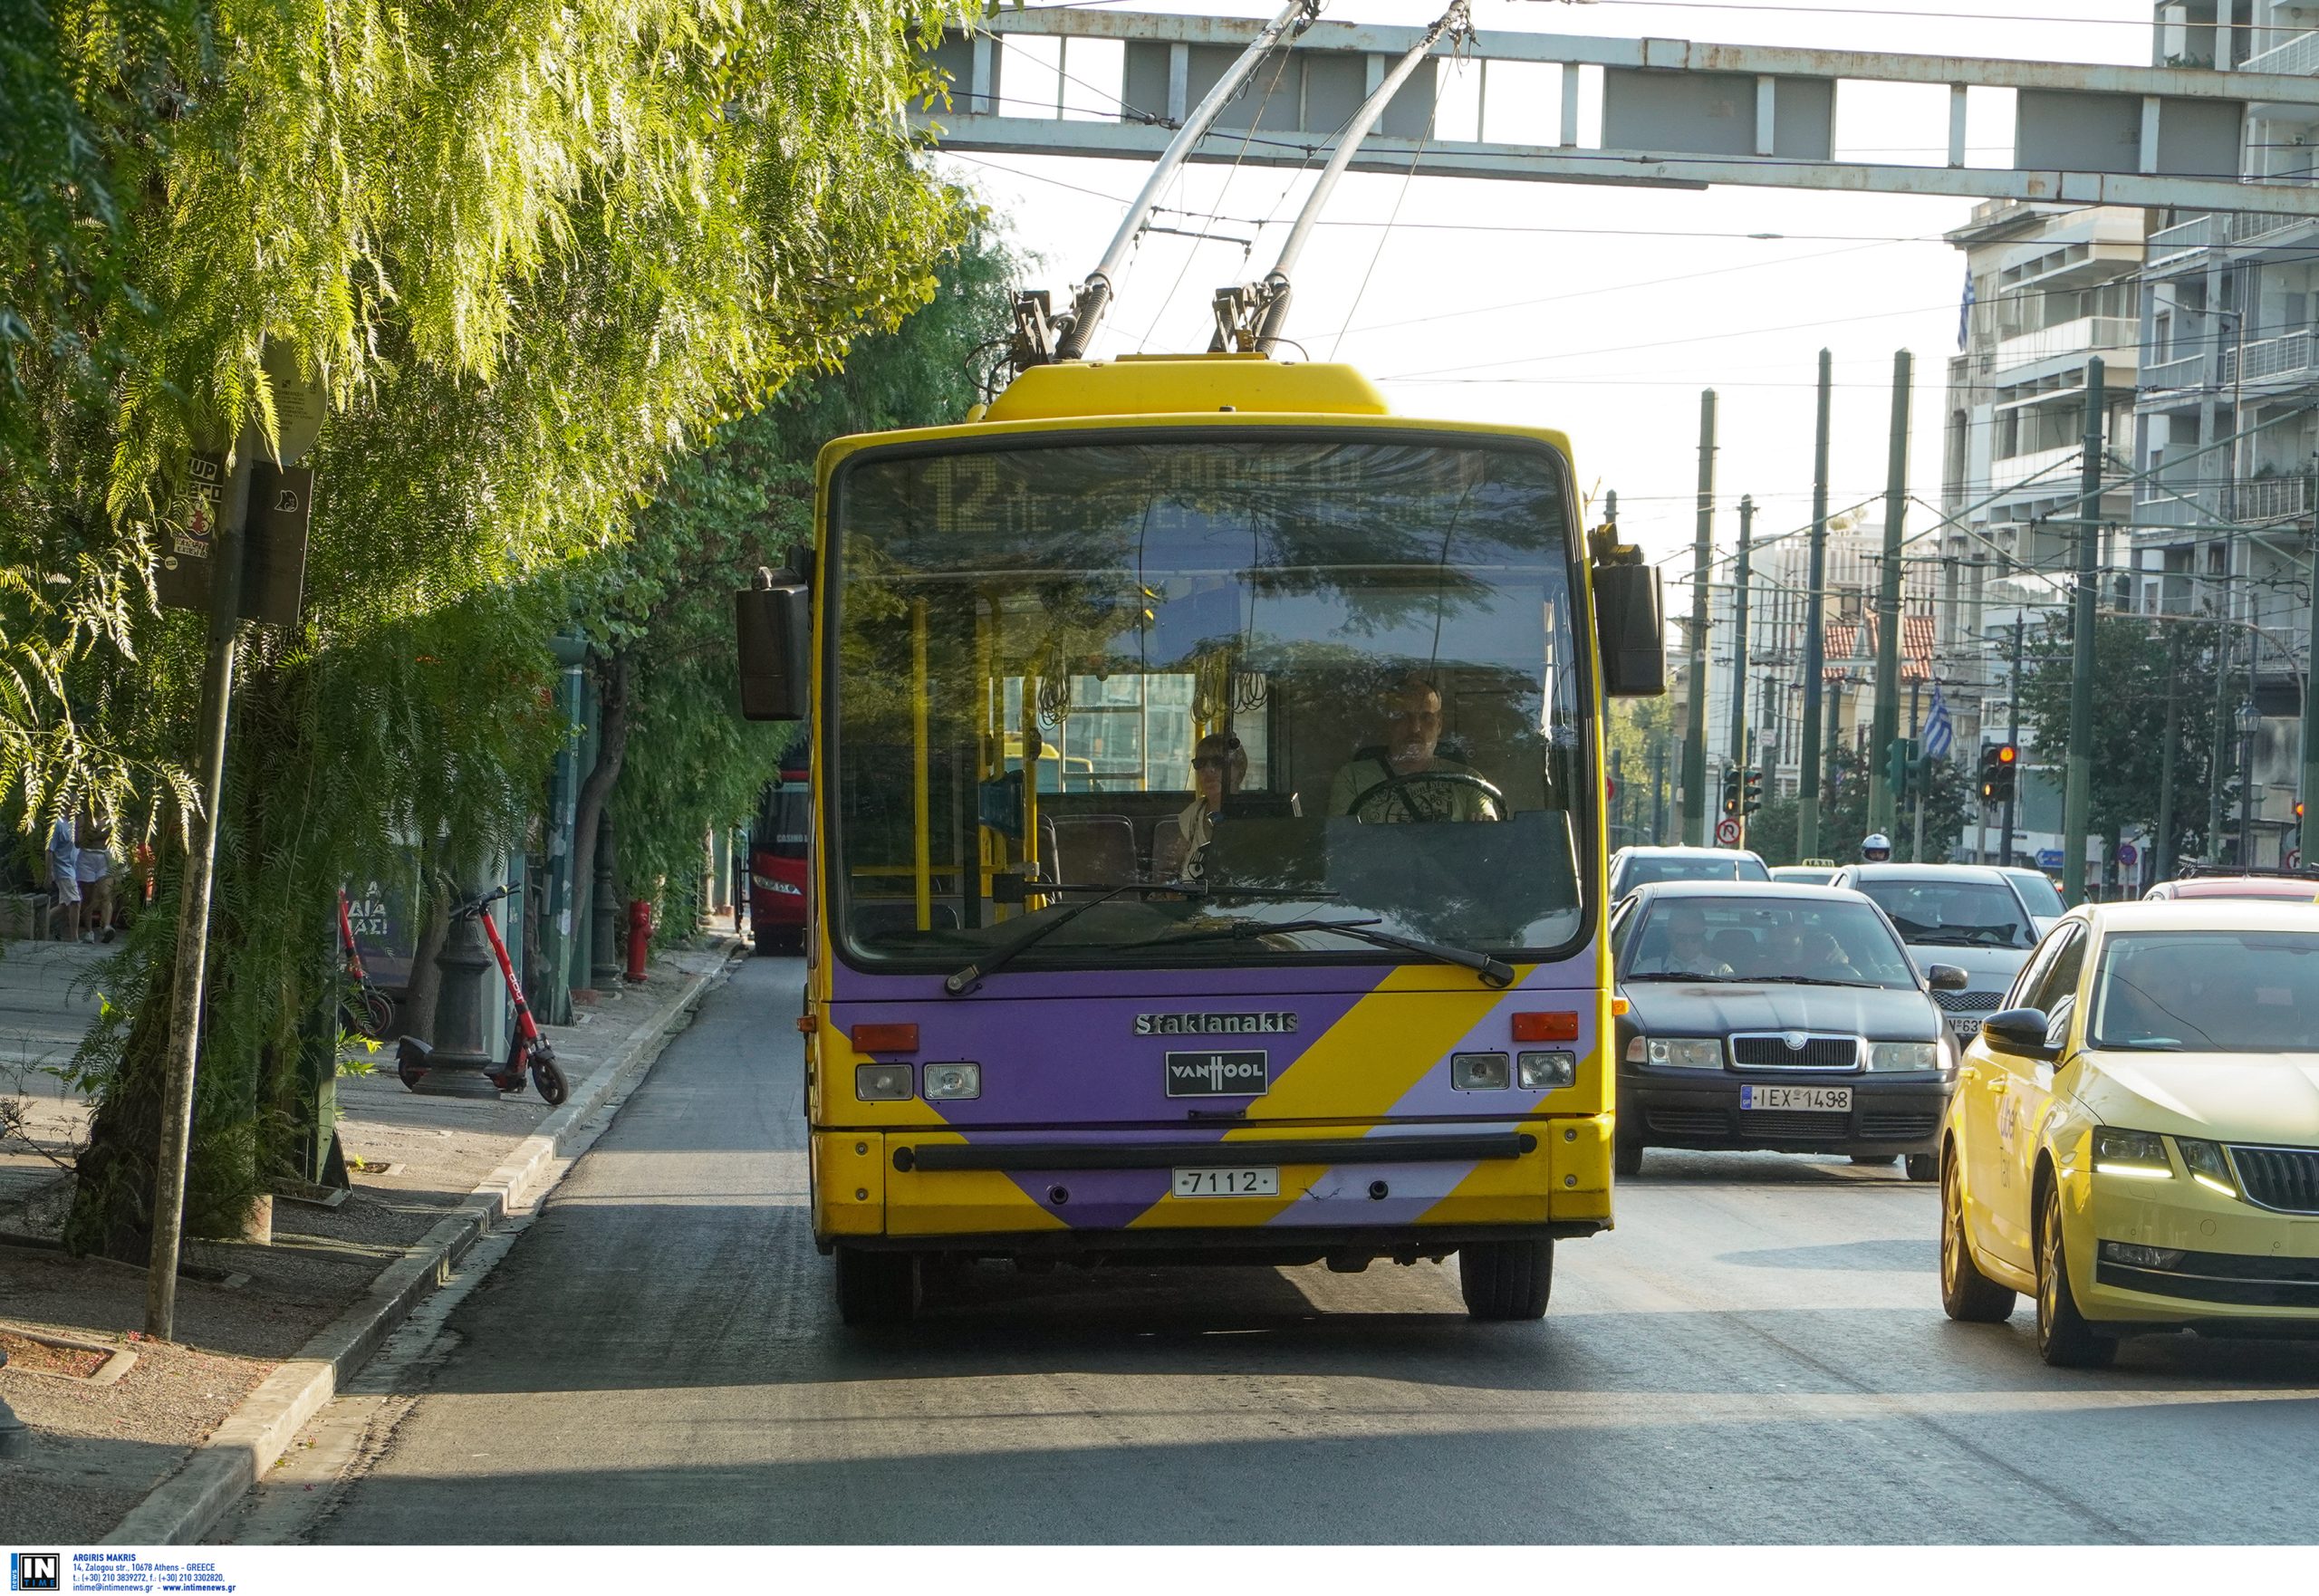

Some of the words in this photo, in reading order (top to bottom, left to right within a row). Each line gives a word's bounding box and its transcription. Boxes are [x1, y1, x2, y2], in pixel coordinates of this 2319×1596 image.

[920, 457, 997, 532] 12
[1135, 1013, 1298, 1034] Sfakianakis
[1188, 1171, 1257, 1192] 7112
